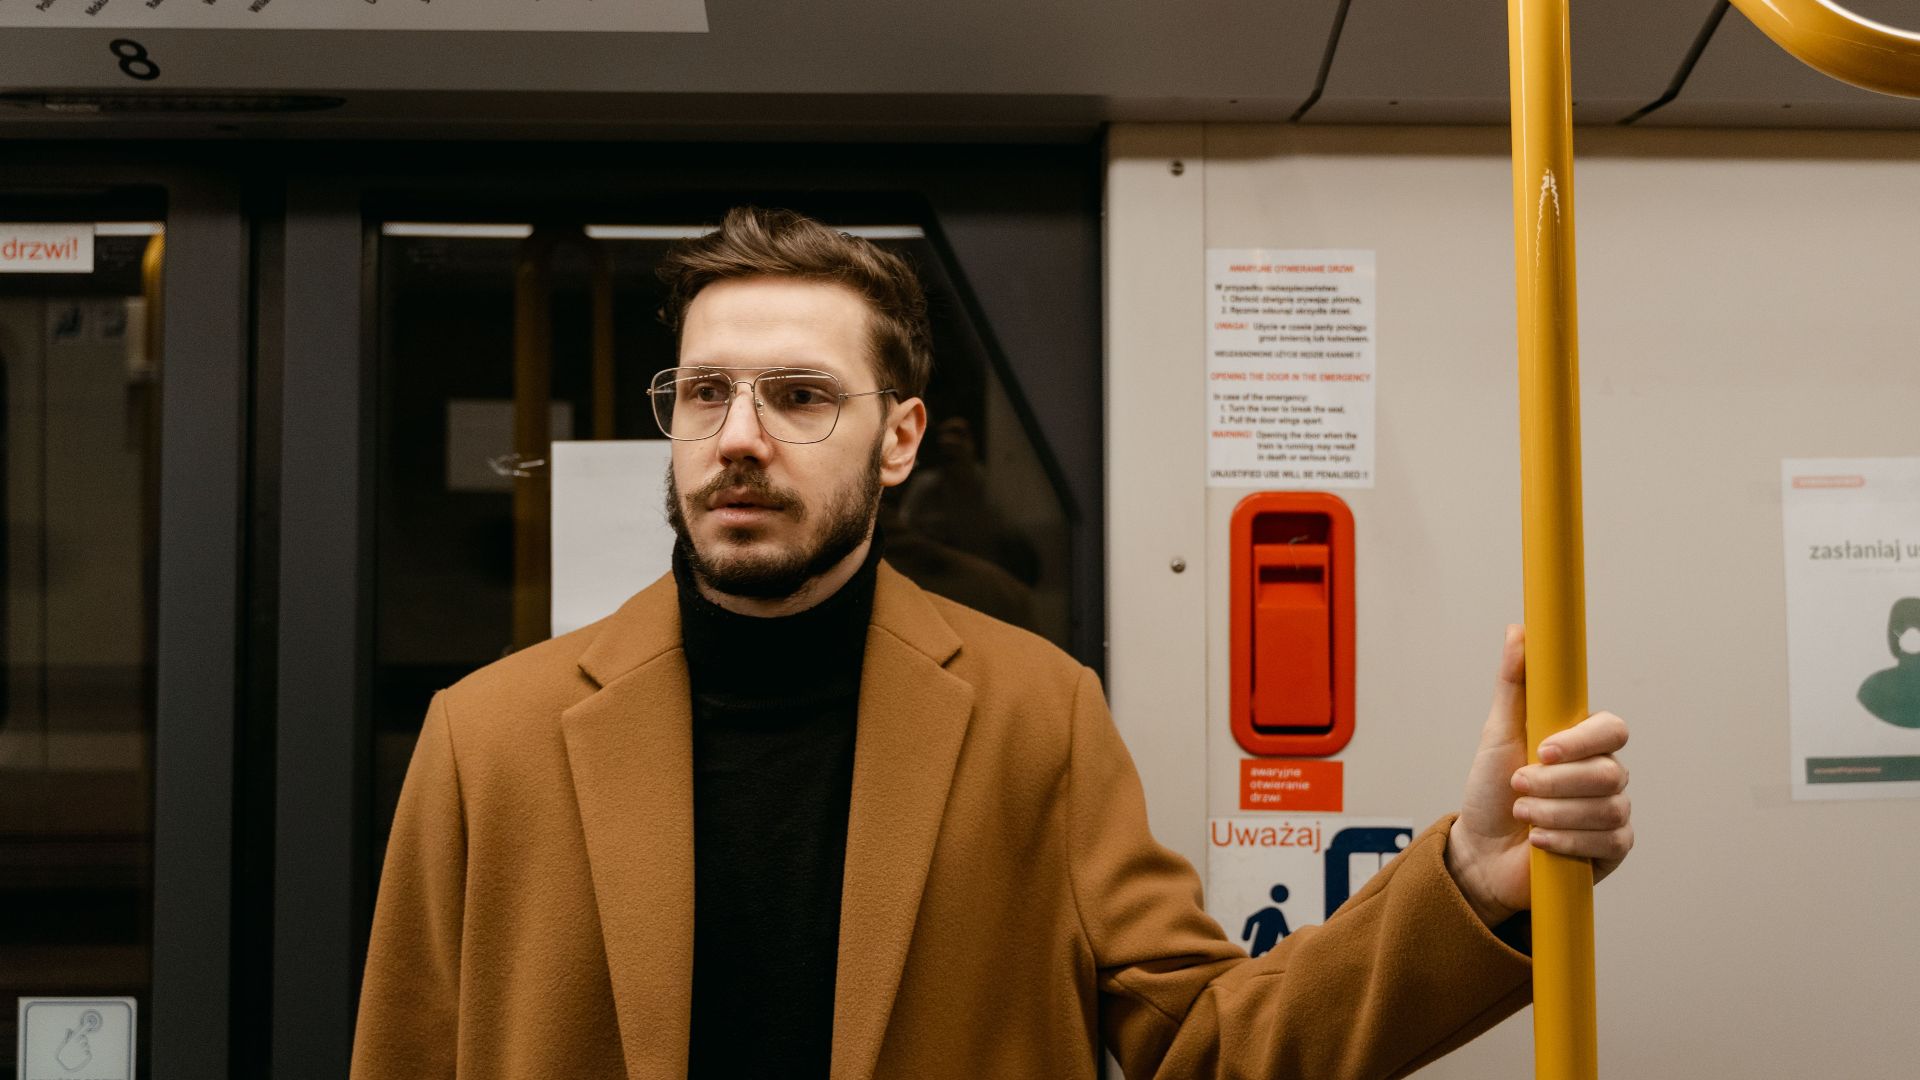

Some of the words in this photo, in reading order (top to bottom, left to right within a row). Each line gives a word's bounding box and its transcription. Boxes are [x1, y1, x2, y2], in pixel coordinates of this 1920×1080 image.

[109, 38, 161, 81] 8
[3, 238, 78, 260] drzwi!
[1210, 372, 1247, 382] OPENING
[1249, 372, 1263, 382] THE
[1265, 372, 1289, 382] DOOR
[1291, 372, 1300, 382] IN
[1302, 372, 1317, 382] THE
[1319, 372, 1370, 382] EMERGENCY
[1222, 392, 1240, 400] case
[1251, 392, 1264, 400] the
[1228, 404, 1246, 412] Turn
[1248, 404, 1258, 412] the
[1290, 404, 1311, 412] break
[1313, 404, 1326, 412] the
[1228, 416, 1242, 424] Pull
[1244, 416, 1257, 424] the
[1259, 416, 1276, 424] door
[1278, 416, 1300, 425] wings
[1256, 430, 1288, 440] Opening
[1290, 430, 1302, 438] the
[1304, 430, 1320, 438] door
[1322, 430, 1342, 438] when
[1344, 430, 1358, 438] the
[1316, 442, 1331, 452] may
[1266, 454, 1287, 462] death
[1264, 470, 1280, 480] USE
[1282, 470, 1300, 480] WILL
[1302, 470, 1314, 480] BE
[1809, 540, 1900, 562] zasłaniaj
[1250, 767, 1301, 778] awaryjne
[1250, 781, 1309, 790] otwieranie
[1250, 793, 1281, 802] drzwi
[1211, 821, 1321, 853] Uważaj
